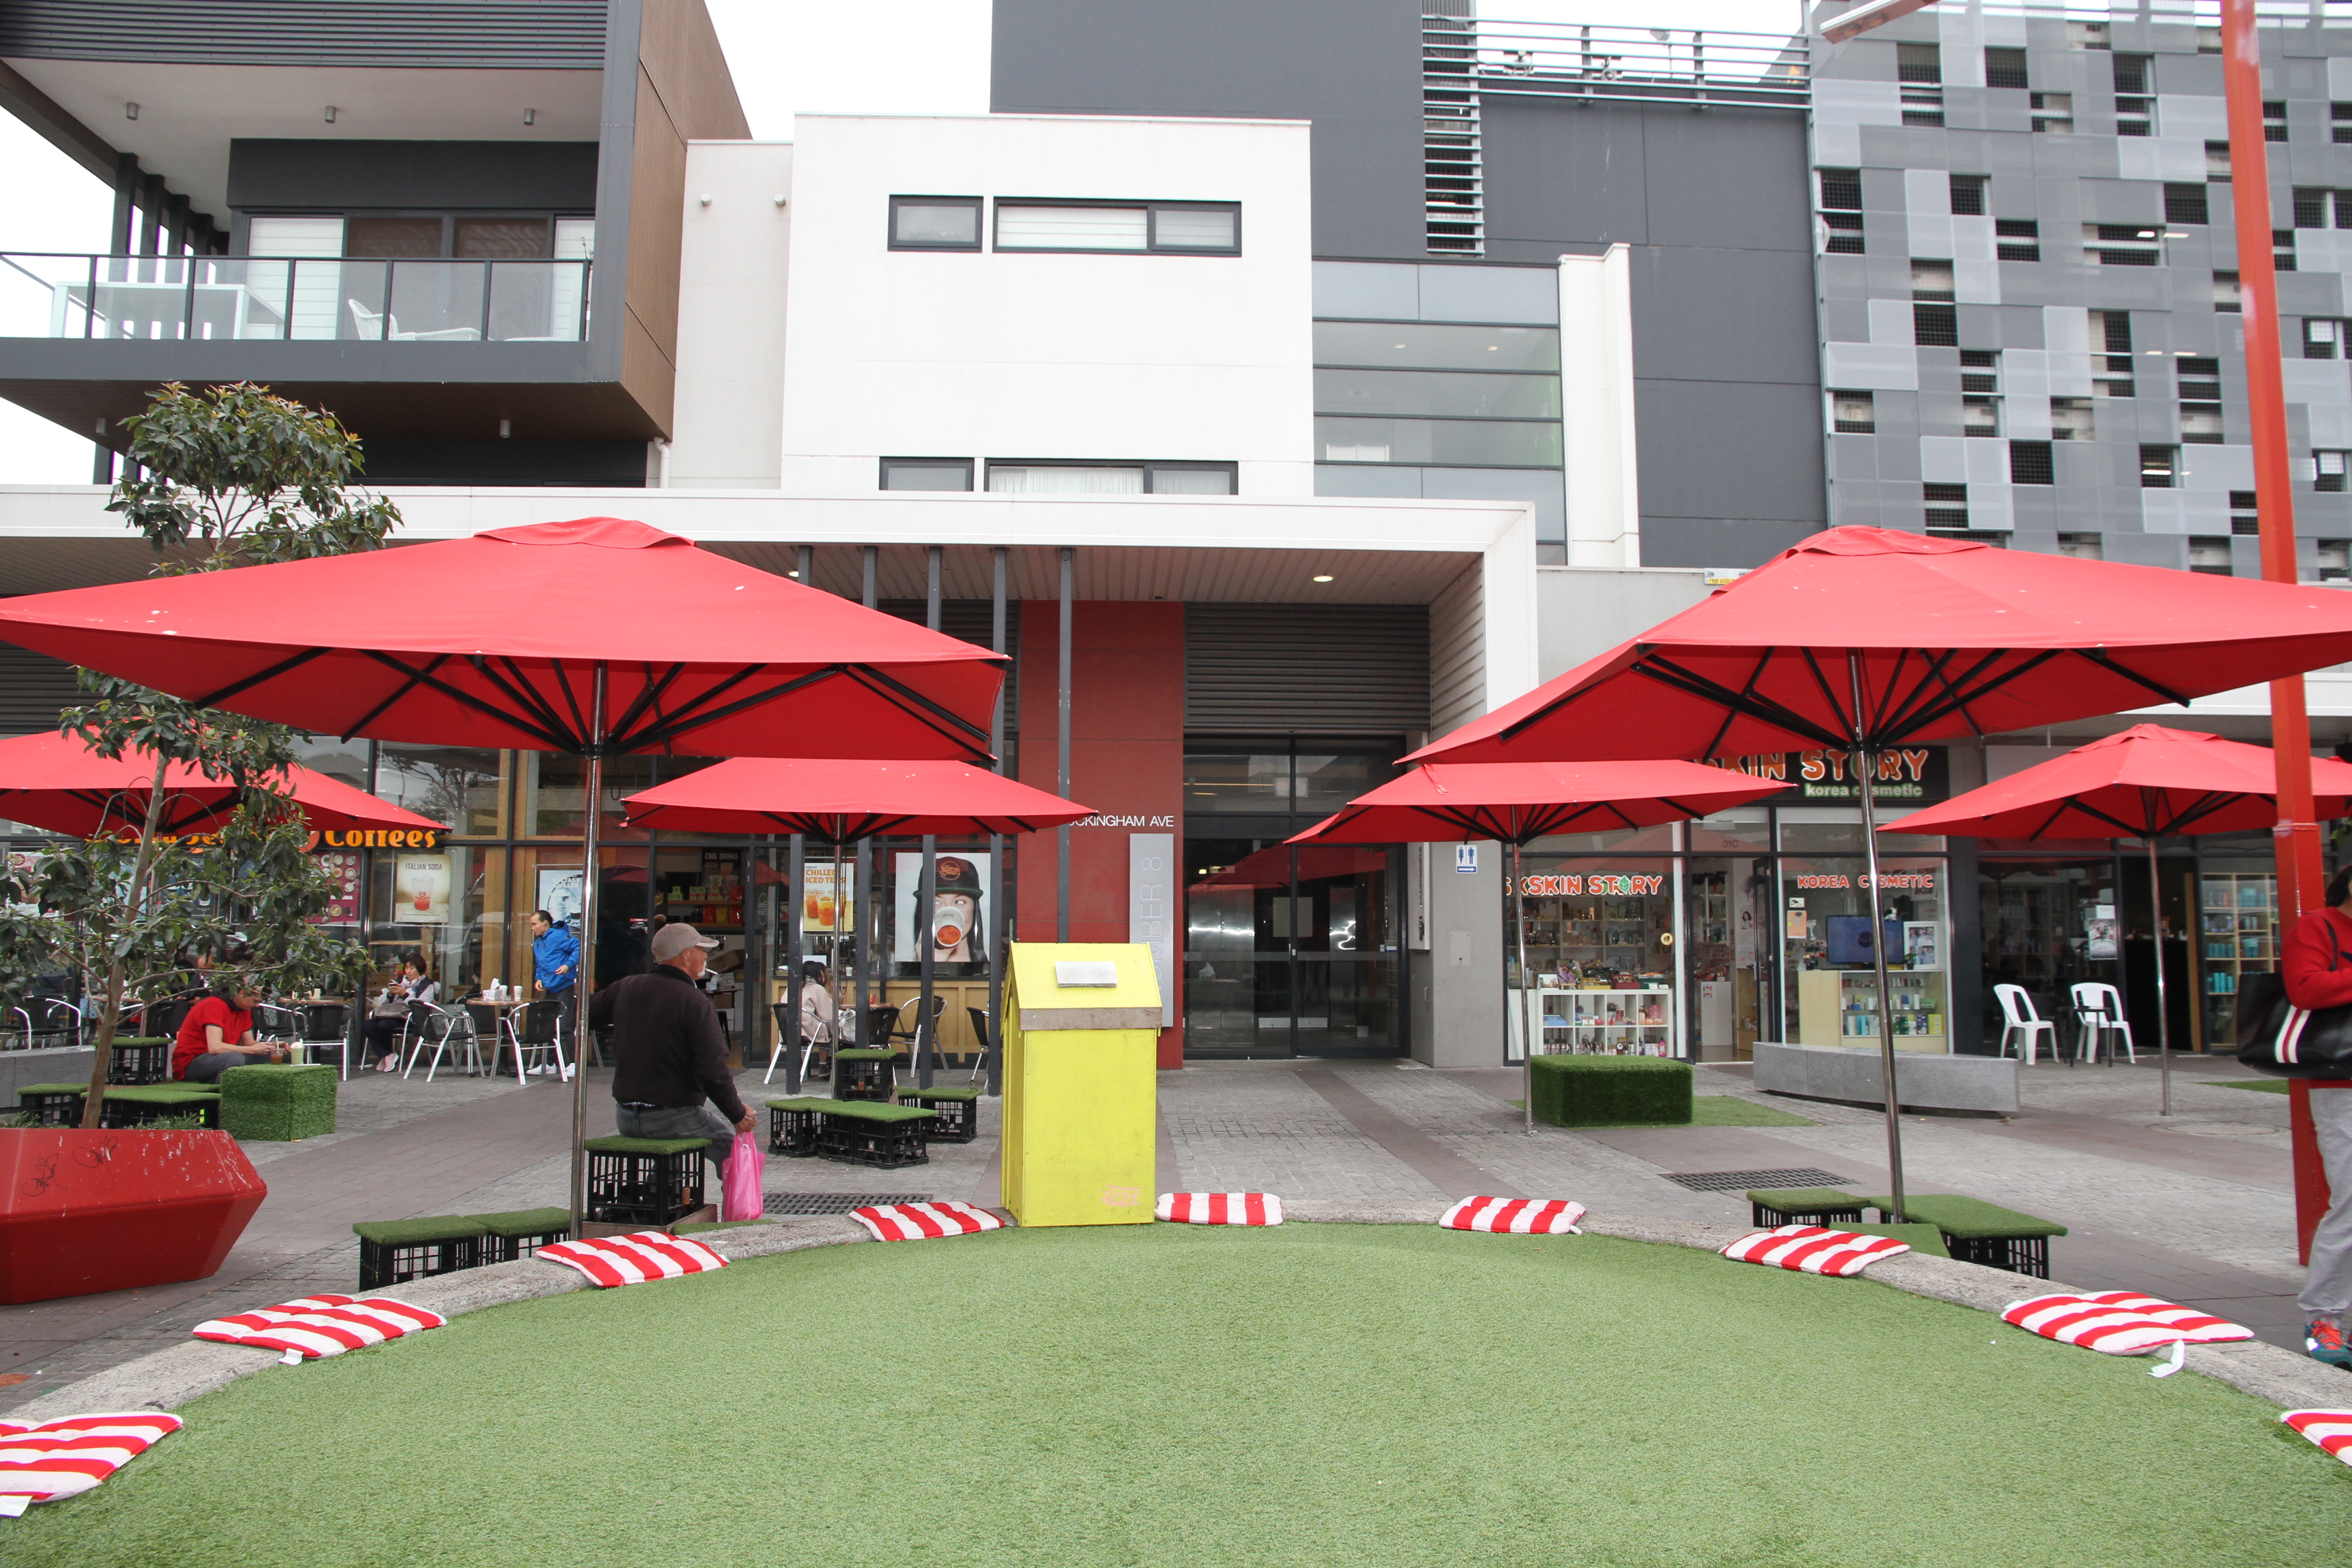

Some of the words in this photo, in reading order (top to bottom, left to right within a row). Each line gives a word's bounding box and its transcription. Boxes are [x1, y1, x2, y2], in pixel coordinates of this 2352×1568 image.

[1695, 751, 1786, 781] KIN
[1805, 782, 1850, 797] korea
[1851, 783, 1923, 797] csmetic
[1069, 815, 1145, 827] CKINGHAM
[1149, 815, 1175, 827] AVE
[1722, 839, 1739, 848] 31C
[1141, 856, 1162, 871] 8
[1528, 875, 1582, 895] SKIN
[1797, 875, 1850, 889] KOREA
[1858, 875, 1934, 889] CSMETIC
[1141, 884, 1162, 990] MBER
